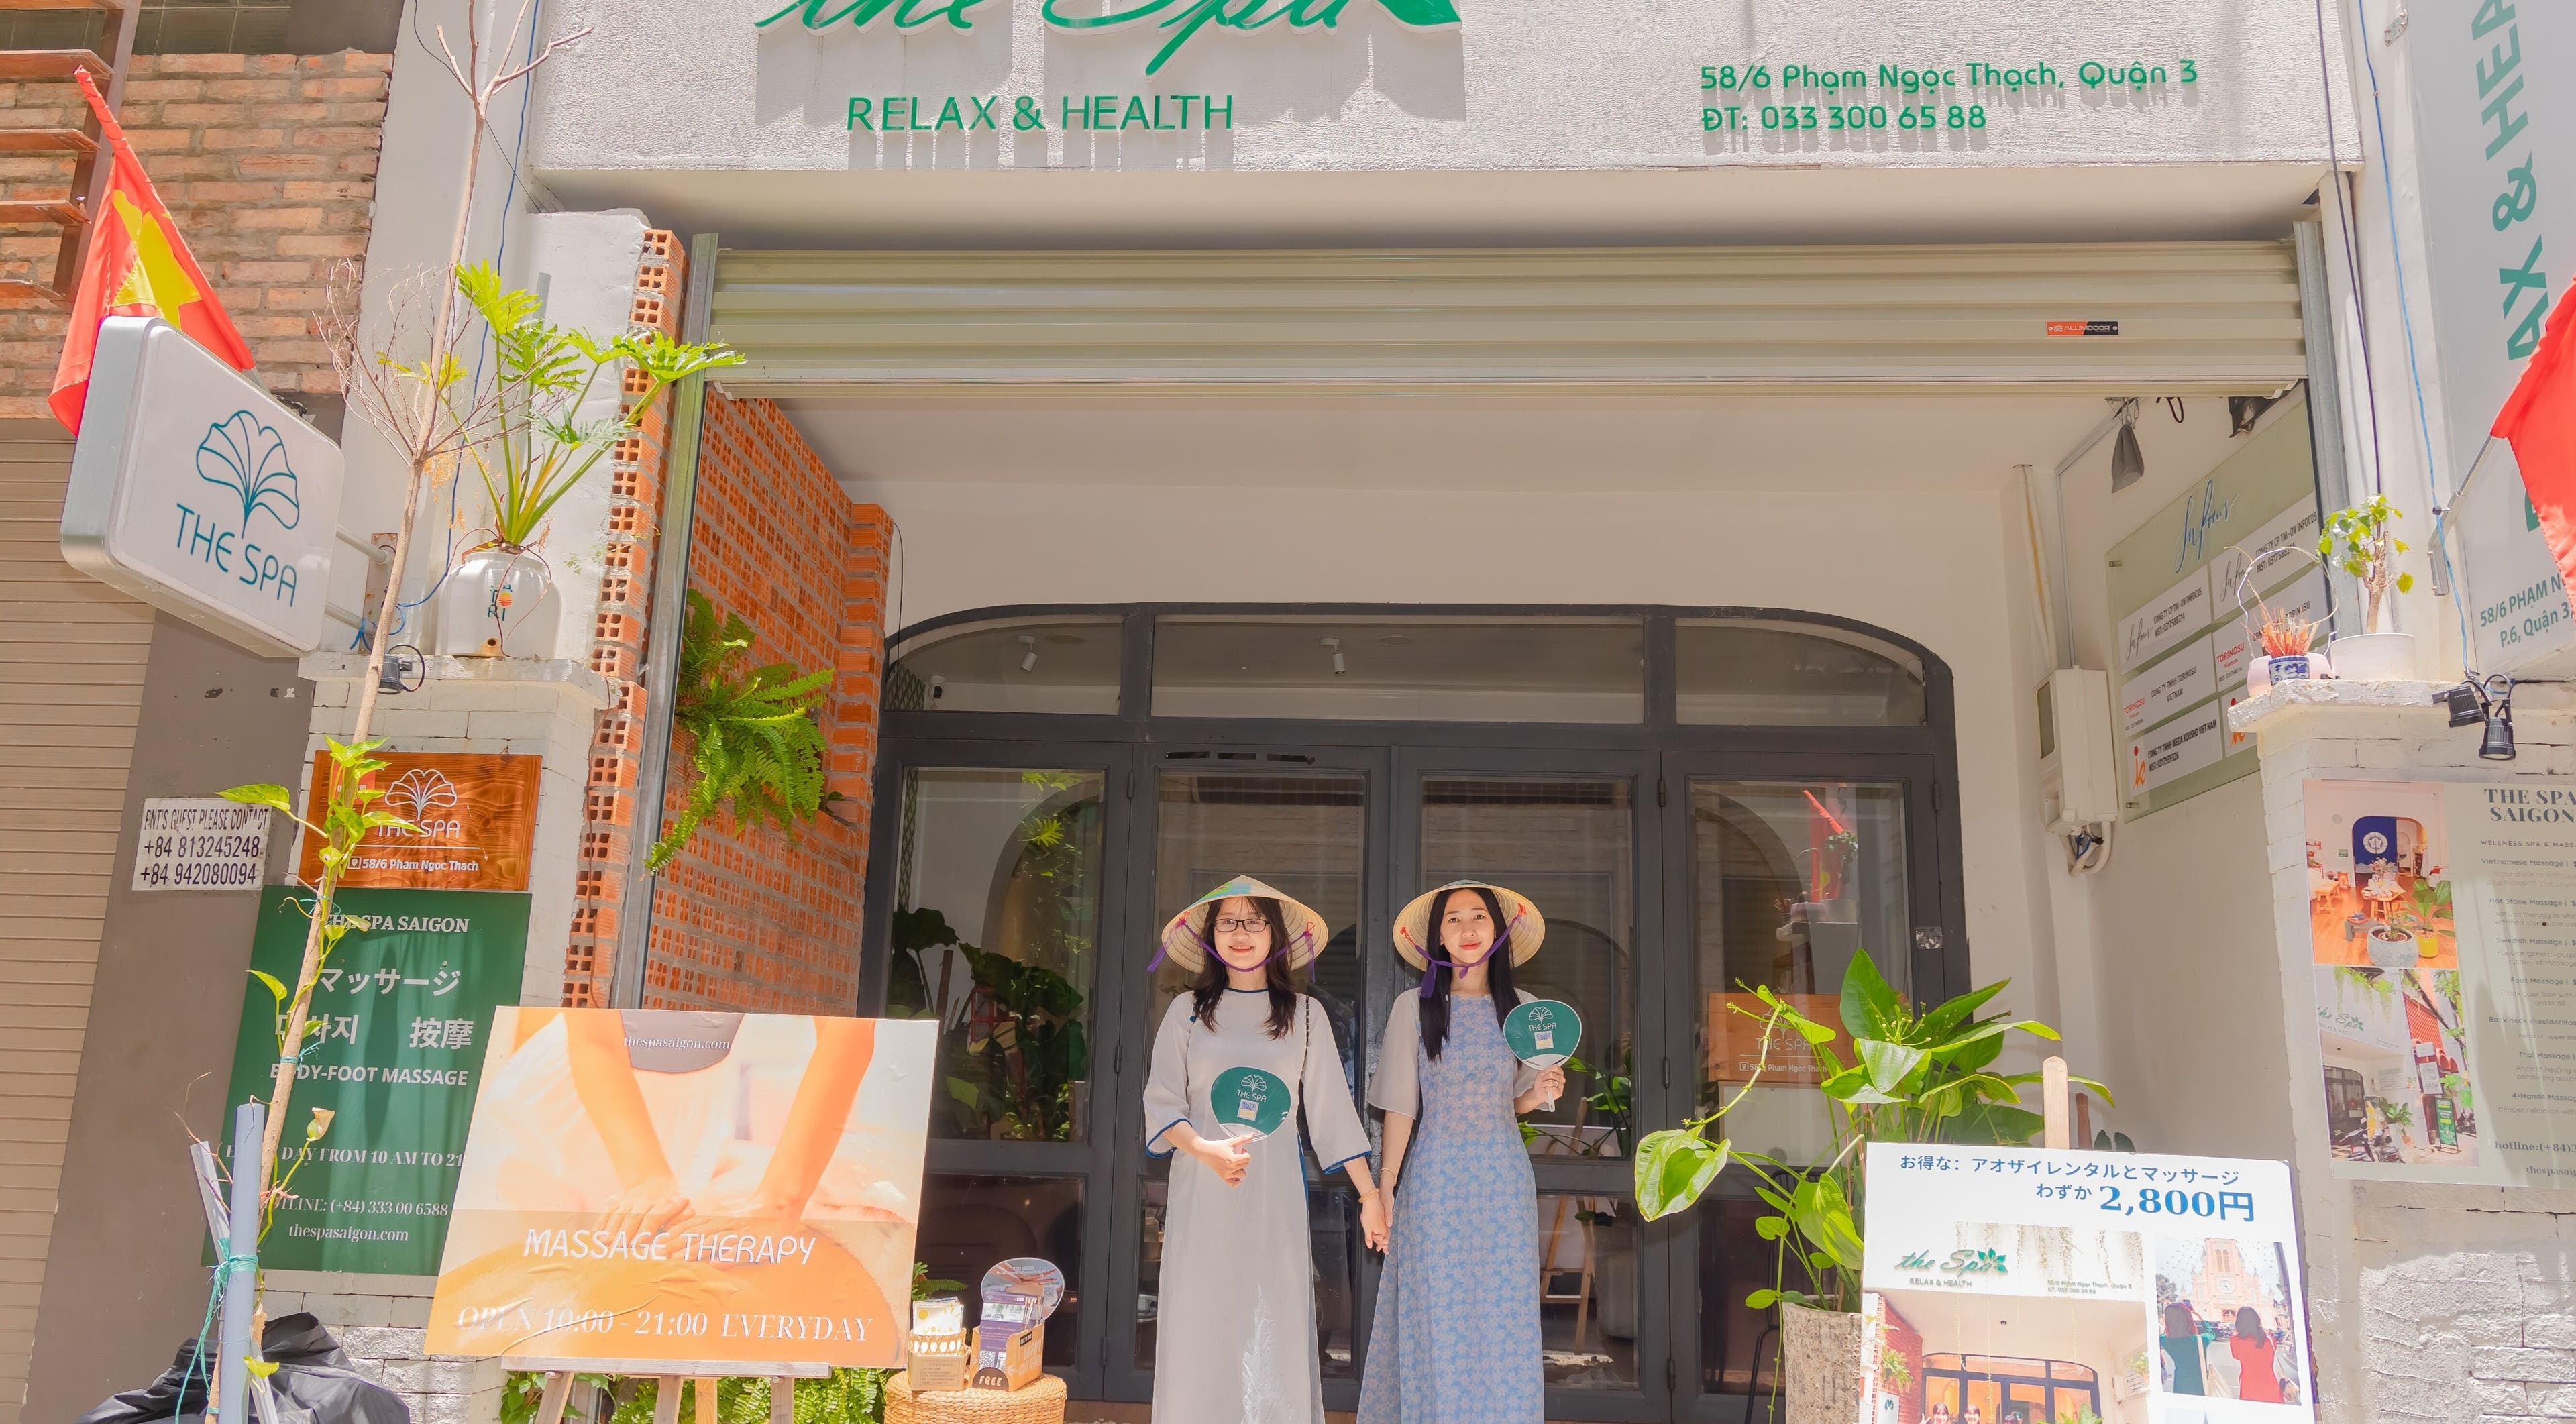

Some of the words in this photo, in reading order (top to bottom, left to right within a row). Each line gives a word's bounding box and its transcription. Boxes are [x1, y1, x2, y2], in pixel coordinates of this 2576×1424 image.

[1701, 65, 1771, 92] 58/6
[1782, 65, 1866, 95] Phạm
[1879, 64, 1955, 94] Ngọc
[1966, 62, 2065, 92] Thạch,
[2078, 60, 2167, 91] Quận
[2180, 59, 2198, 83] 3
[847, 96, 998, 131] RELAX
[1013, 97, 1046, 130] &
[1062, 95, 1233, 130] HEALTH
[1701, 107, 1747, 131] ĐT:
[1761, 105, 1818, 130] 033
[1829, 105, 1887, 129] 300
[1898, 105, 1937, 129] 65
[1947, 105, 1986, 129] 88
[2296, 511, 2318, 532] INFOCUS
[176, 503, 235, 573] THE
[239, 543, 297, 606] SPA
[2480, 601, 2506, 627] 58/6
[2509, 580, 2548, 613] PHẠM
[2500, 625, 2521, 648] P.6,
[2524, 610, 2559, 637] Quận
[2216, 642, 2245, 663] TORINOSU
[2166, 688, 2184, 702] VIETNAM
[2206, 718, 2218, 731] NAM
[2483, 788, 2530, 804] THE
[2536, 790, 2576, 805] SPA
[199, 808, 229, 830] PLEASE
[231, 808, 269, 830] CONTACT
[2489, 806, 2575, 824] SAIGON
[419, 820, 461, 838] SPA
[144, 836, 172, 858] +84
[178, 836, 260, 858] 813245248
[362, 859, 388, 869] 58/6
[389, 859, 419, 870] Pham
[421, 860, 447, 872] Ngoc
[449, 860, 479, 871] Thach
[2529, 859, 2564, 867] Massage
[140, 863, 169, 885] +84
[174, 863, 256, 885] 942080094
[2529, 899, 2563, 908] Massage
[398, 916, 470, 932] SAIGON
[319, 967, 462, 997] マッサージ
[2530, 978, 2564, 986] Massage
[408, 1016, 474, 1050] 按摩
[1527, 1024, 1542, 1032] THE
[1542, 1022, 1557, 1030] SPA
[623, 1034, 731, 1052] thespasaigon.com
[2537, 1052, 2571, 1060] Massage
[270, 1063, 378, 1083] BDY-FOOT
[382, 1068, 468, 1085] MASSAGE
[1768, 1063, 1787, 1072] Pham
[1788, 1064, 1806, 1074] Ngoc
[1237, 1089, 1250, 1099] THE
[1251, 1093, 1267, 1103] SPA
[282, 1146, 317, 1161] DAY
[319, 1148, 366, 1164] FROM
[370, 1150, 388, 1164] 10
[390, 1151, 417, 1166] AM
[421, 1152, 443, 1166] TO
[330, 1198, 365, 1214] (+84)
[368, 1201, 392, 1215] 333
[395, 1201, 413, 1215] 00
[415, 1203, 449, 1217] 6588
[2035, 1183, 2093, 1202] わずか
[2098, 1185, 2255, 1223] 2,800円
[289, 1223, 409, 1243] thespasaigon.com
[523, 1229, 670, 1262] MASSAGE
[680, 1233, 816, 1265] THERAPY
[1894, 1248, 1936, 1269] the
[1909, 1277, 1934, 1286] RELAX
[1935, 1278, 1942, 1286] &
[1943, 1278, 1972, 1288] HEALTH
[457, 1306, 537, 1333] OPEN
[543, 1308, 613, 1335] 10:00
[635, 1310, 708, 1337] 21:00
[721, 1313, 873, 1342] EVERYDAY
[979, 1375, 1003, 1386] FREE
